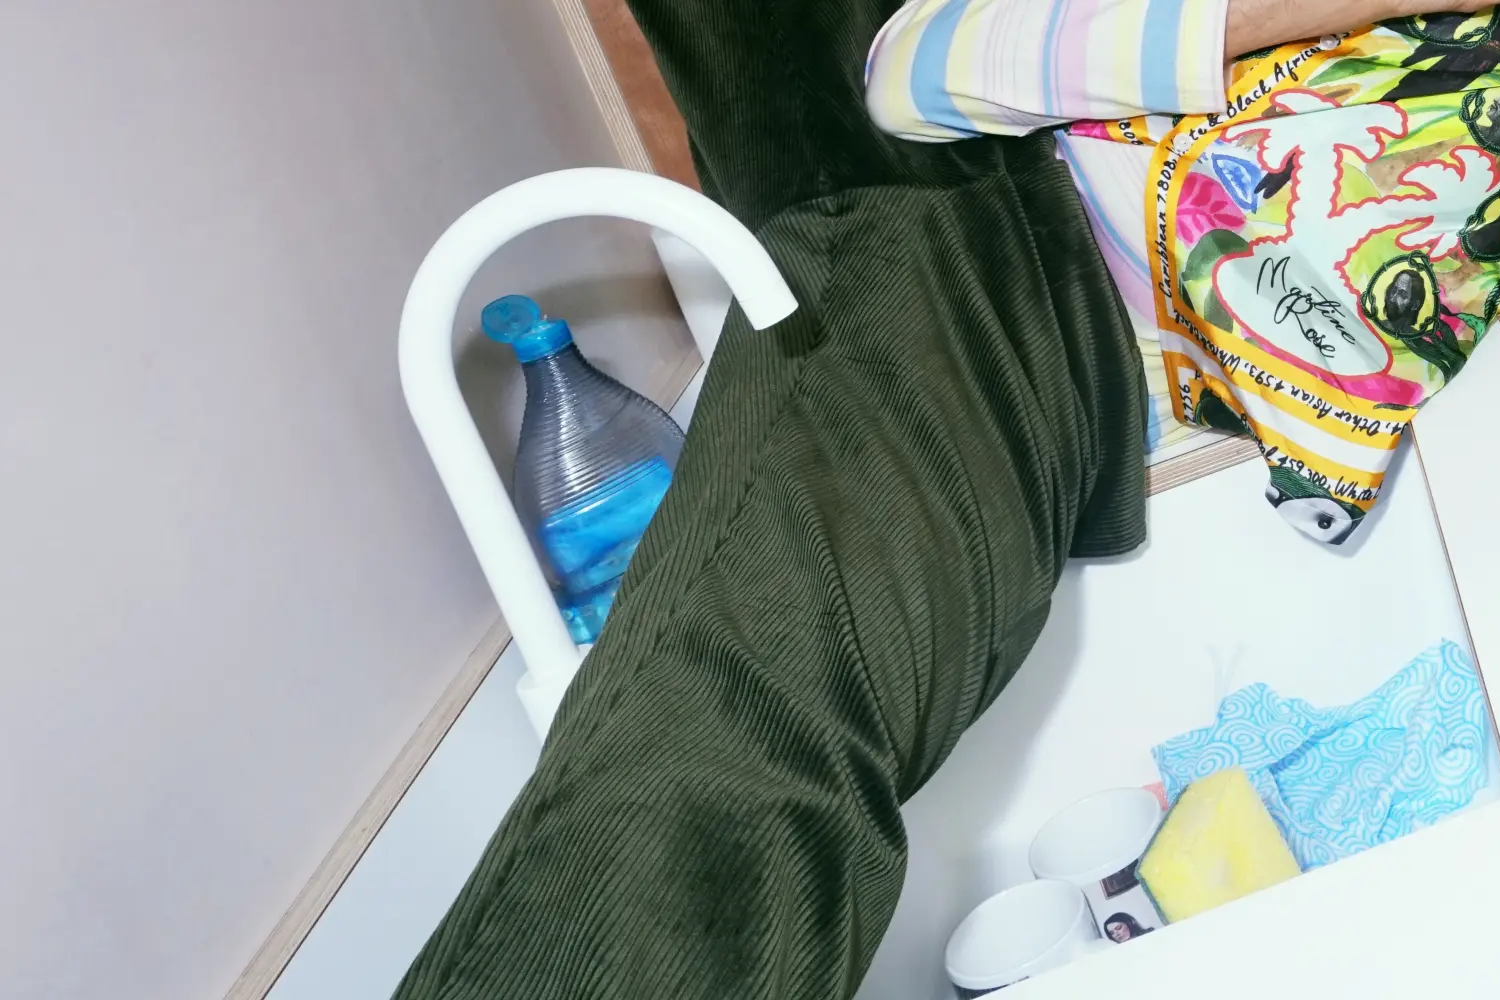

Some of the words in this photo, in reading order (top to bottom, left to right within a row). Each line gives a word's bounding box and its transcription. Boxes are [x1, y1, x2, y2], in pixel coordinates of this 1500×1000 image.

[1155, 208, 1174, 298] Caribbean
[1207, 112, 1224, 128] &
[1226, 80, 1272, 119] Black
[1256, 256, 1357, 346] Martine
[1273, 293, 1336, 359] Rose
[1289, 384, 1334, 419] Asian
[1334, 410, 1382, 437] Other
